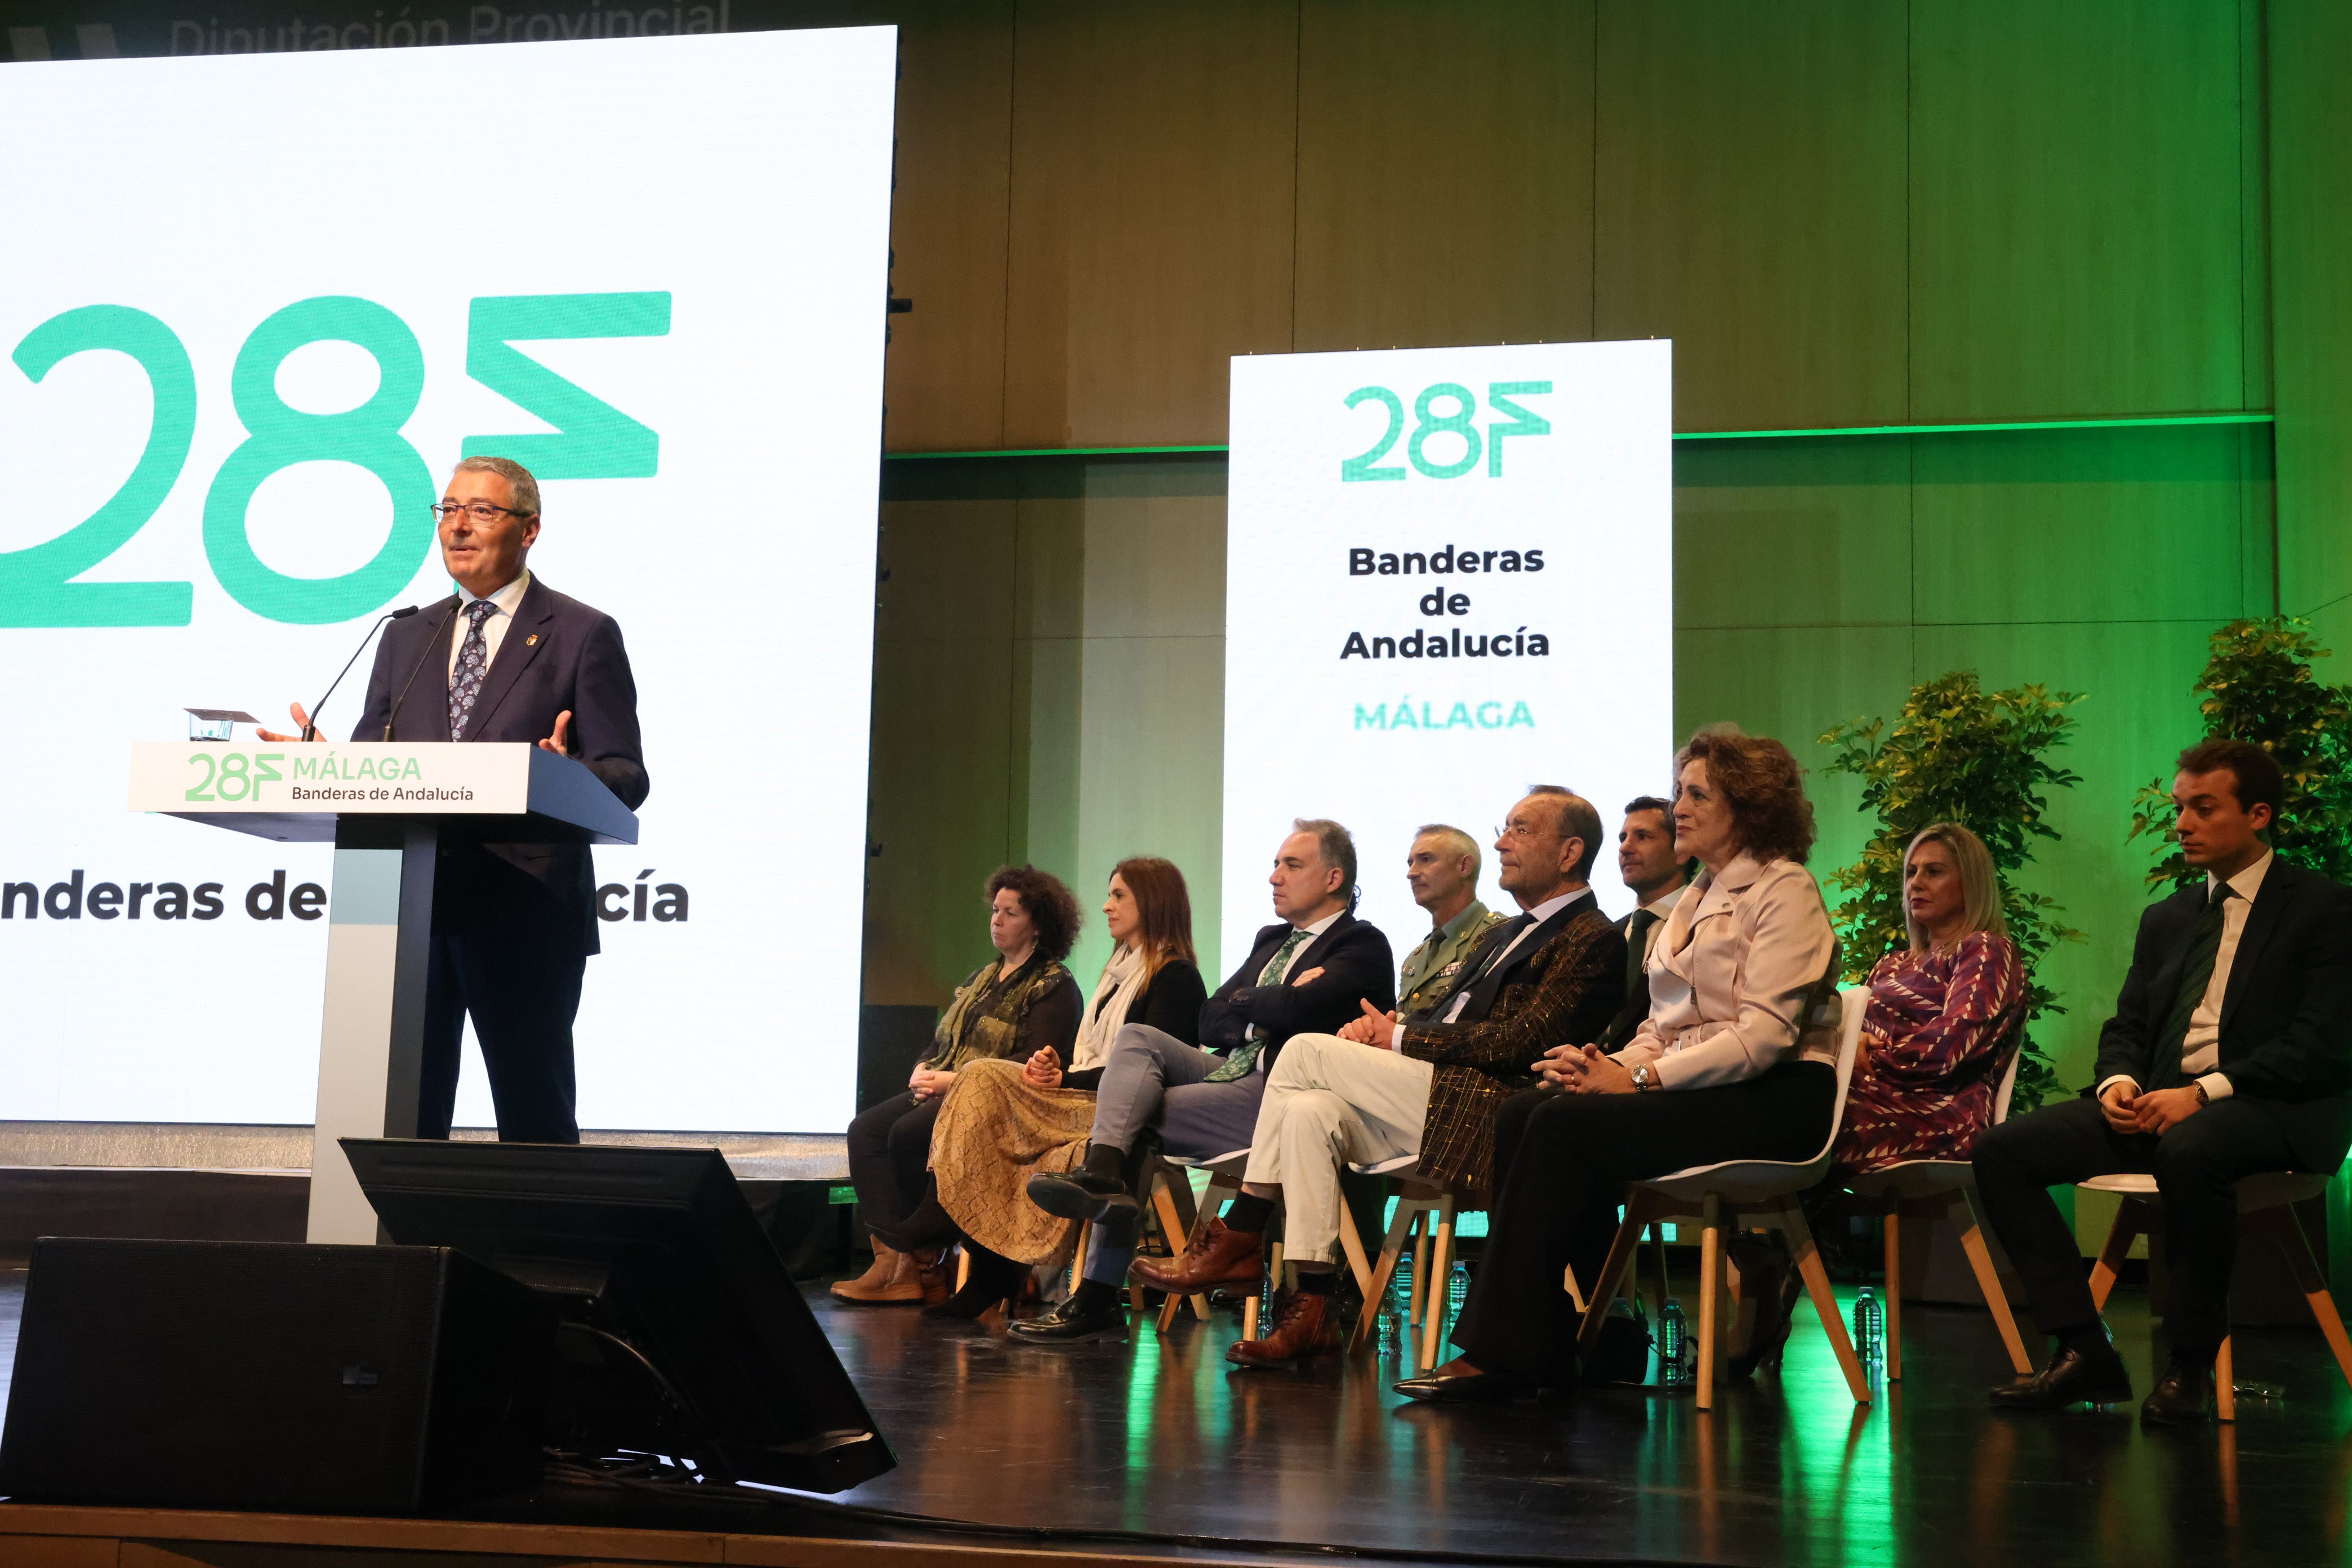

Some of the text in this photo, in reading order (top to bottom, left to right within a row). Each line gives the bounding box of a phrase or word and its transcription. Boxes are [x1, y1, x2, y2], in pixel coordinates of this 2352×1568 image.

[171, 0, 730, 56] Diputación Provincial
[1342, 380, 1553, 483] 28F
[1349, 544, 1544, 576] Banderas
[1419, 587, 1471, 616] de
[1340, 626, 1549, 660] Andalucía
[1354, 694, 1536, 730] MÁLAGA
[185, 751, 422, 802] 28F MÁLAGA
[292, 787, 474, 801] Banderas de Andalucía
[1, 869, 327, 921] nderas de
